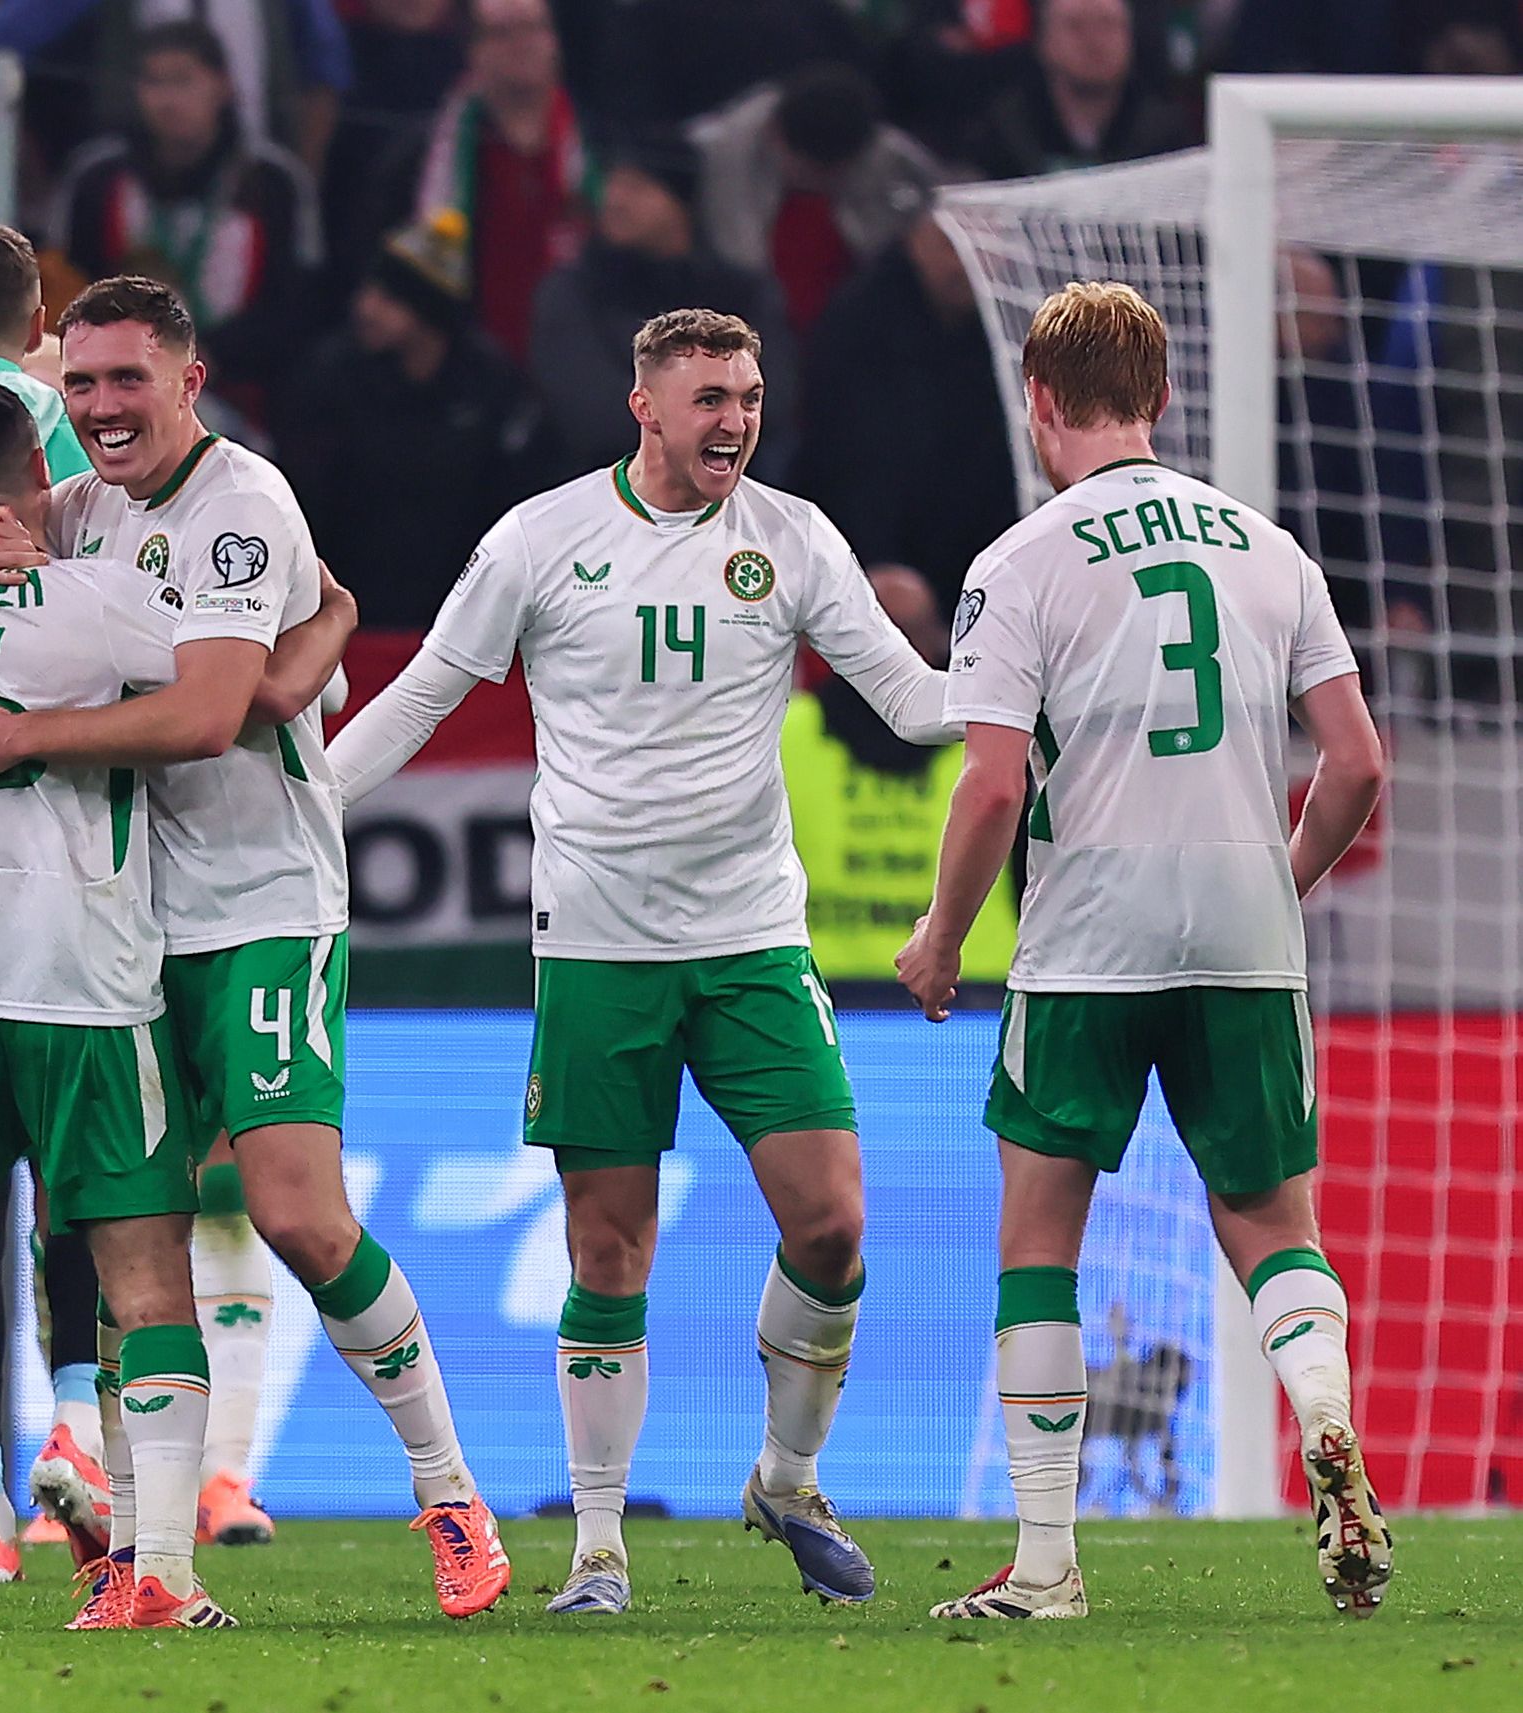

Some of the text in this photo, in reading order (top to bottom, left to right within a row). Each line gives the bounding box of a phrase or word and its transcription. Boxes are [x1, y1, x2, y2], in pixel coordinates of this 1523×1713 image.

[1072, 497, 1250, 564] SCALES
[635, 604, 706, 682] 14
[1132, 561, 1224, 757] 3
[250, 987, 291, 1061] 4
